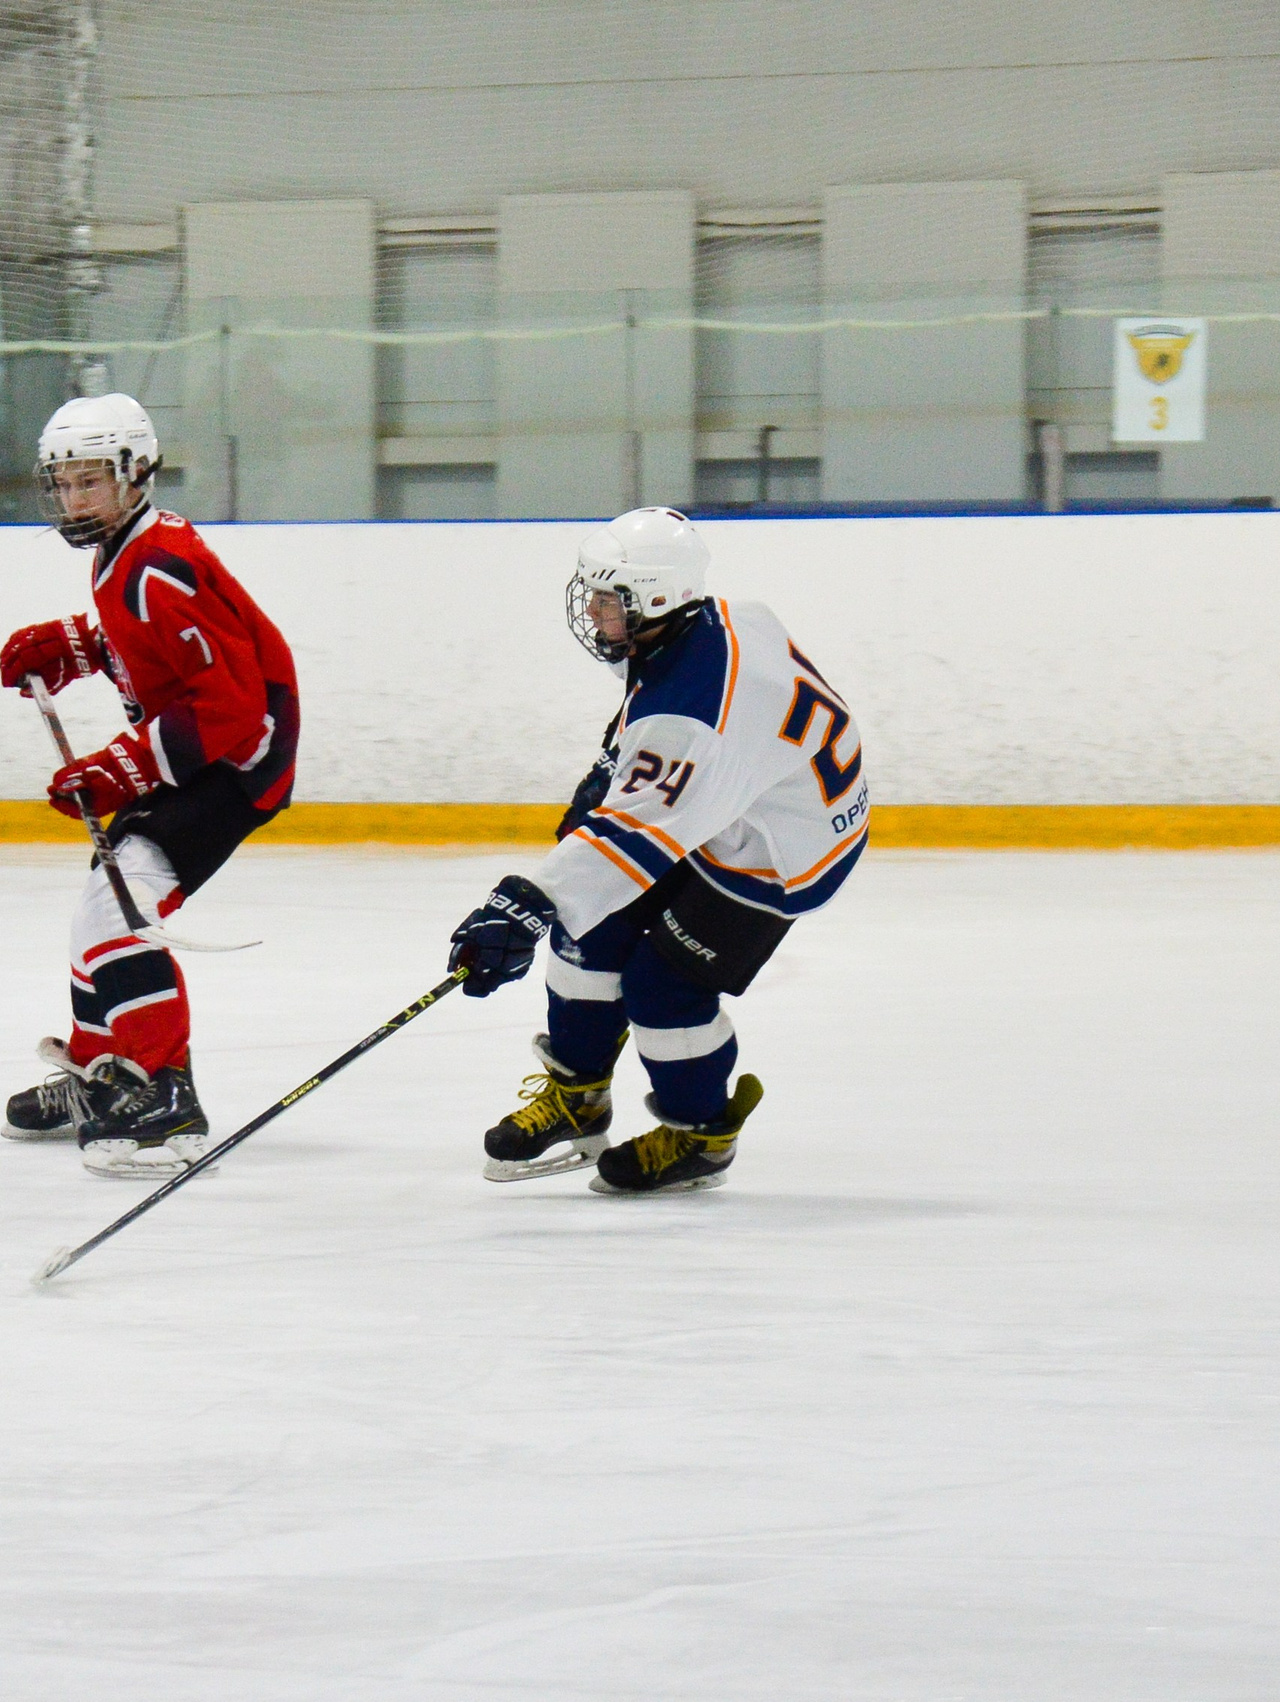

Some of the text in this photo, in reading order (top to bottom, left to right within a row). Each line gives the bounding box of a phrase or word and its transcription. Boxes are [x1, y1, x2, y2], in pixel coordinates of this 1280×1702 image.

[1148, 396, 1168, 431] 3
[179, 625, 213, 664] 7
[777, 637, 862, 808] 2
[620, 750, 695, 807] 24
